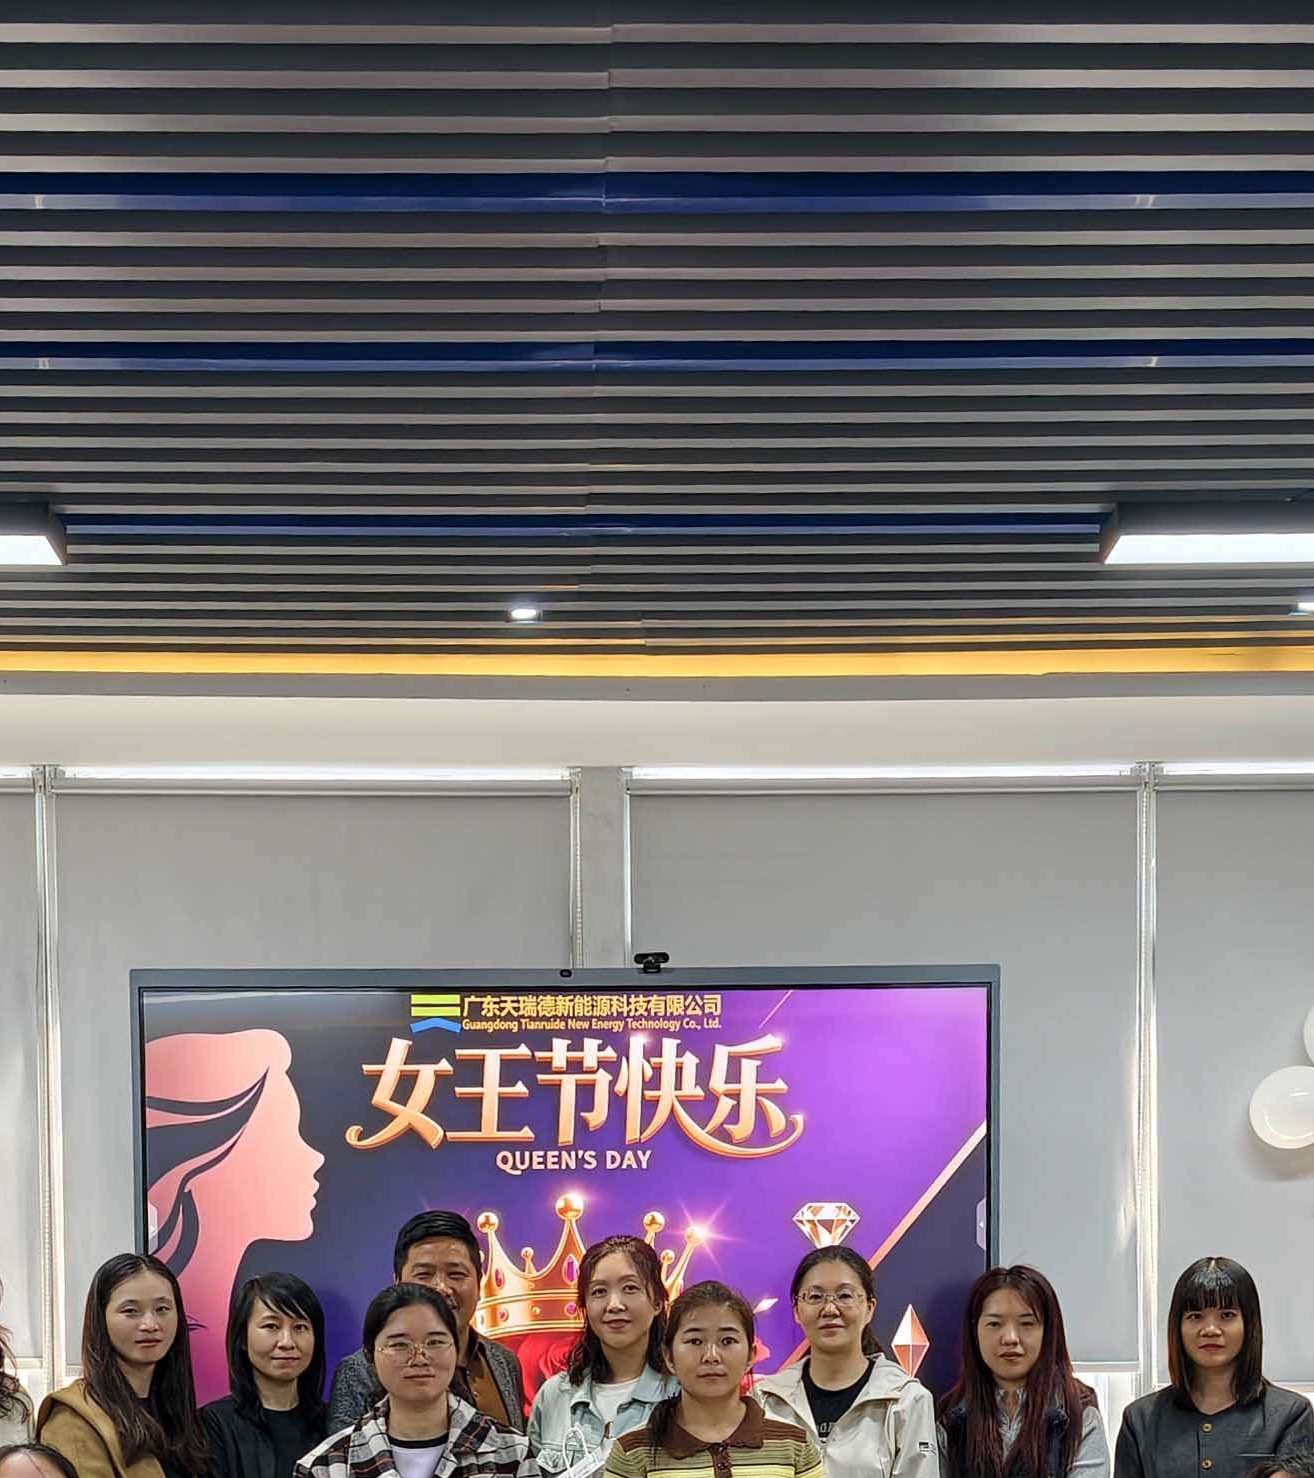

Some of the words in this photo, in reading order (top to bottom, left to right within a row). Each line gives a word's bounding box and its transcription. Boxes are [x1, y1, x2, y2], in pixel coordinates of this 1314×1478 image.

[462, 994, 722, 1017] 广东天瑞德新能源科技有限公司
[462, 1018, 519, 1033] Guangdong
[520, 1018, 567, 1031] Tianruide
[568, 1019, 589, 1031] New
[592, 1019, 624, 1033] Energy
[627, 1018, 682, 1033] Technology
[683, 1019, 701, 1031] Co.,
[703, 1019, 722, 1031] Ltd.
[344, 1034, 805, 1159] 女王节快乐
[496, 1150, 598, 1175] QUEEN'S
[605, 1150, 652, 1170] DAY
